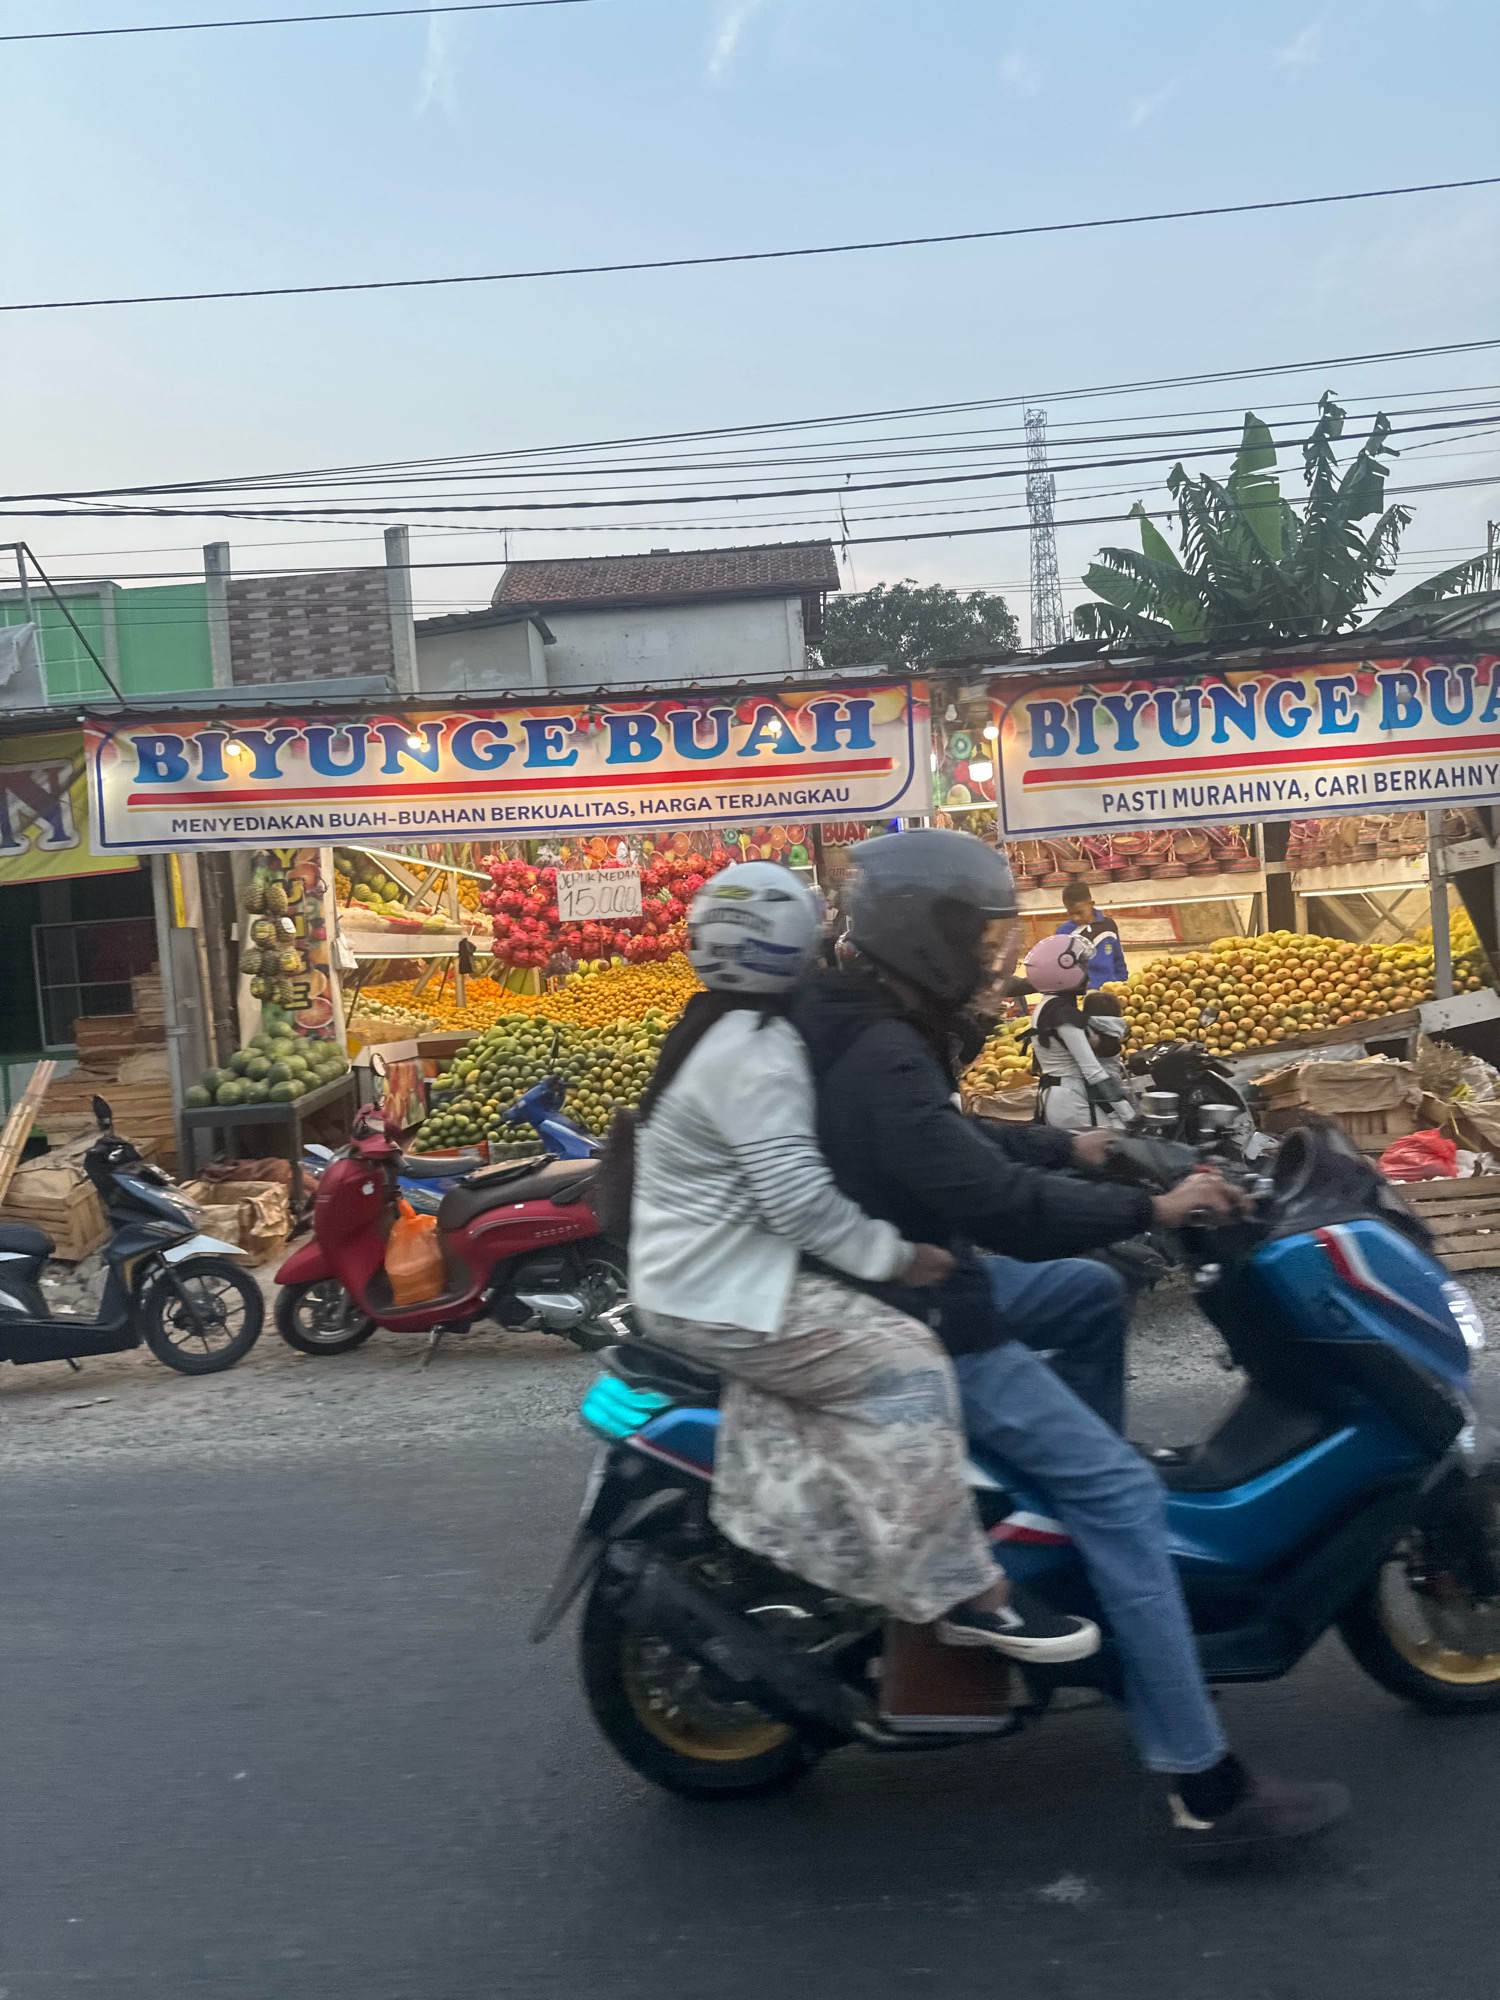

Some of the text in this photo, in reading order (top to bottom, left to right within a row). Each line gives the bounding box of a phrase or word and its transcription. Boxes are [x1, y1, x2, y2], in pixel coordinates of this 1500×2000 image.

[130, 699, 876, 783] BIYUNGE BUAH
[1026, 676, 1359, 758] BIYUNGE
[172, 787, 850, 833] MENYEDIAKAN BUAH-BUAHAN BERKUALITAS, HARGA TERJANGKAU
[1102, 789, 1166, 813] PASTI
[1173, 779, 1310, 809] MURAHNYA,
[1315, 773, 1367, 798] CARI
